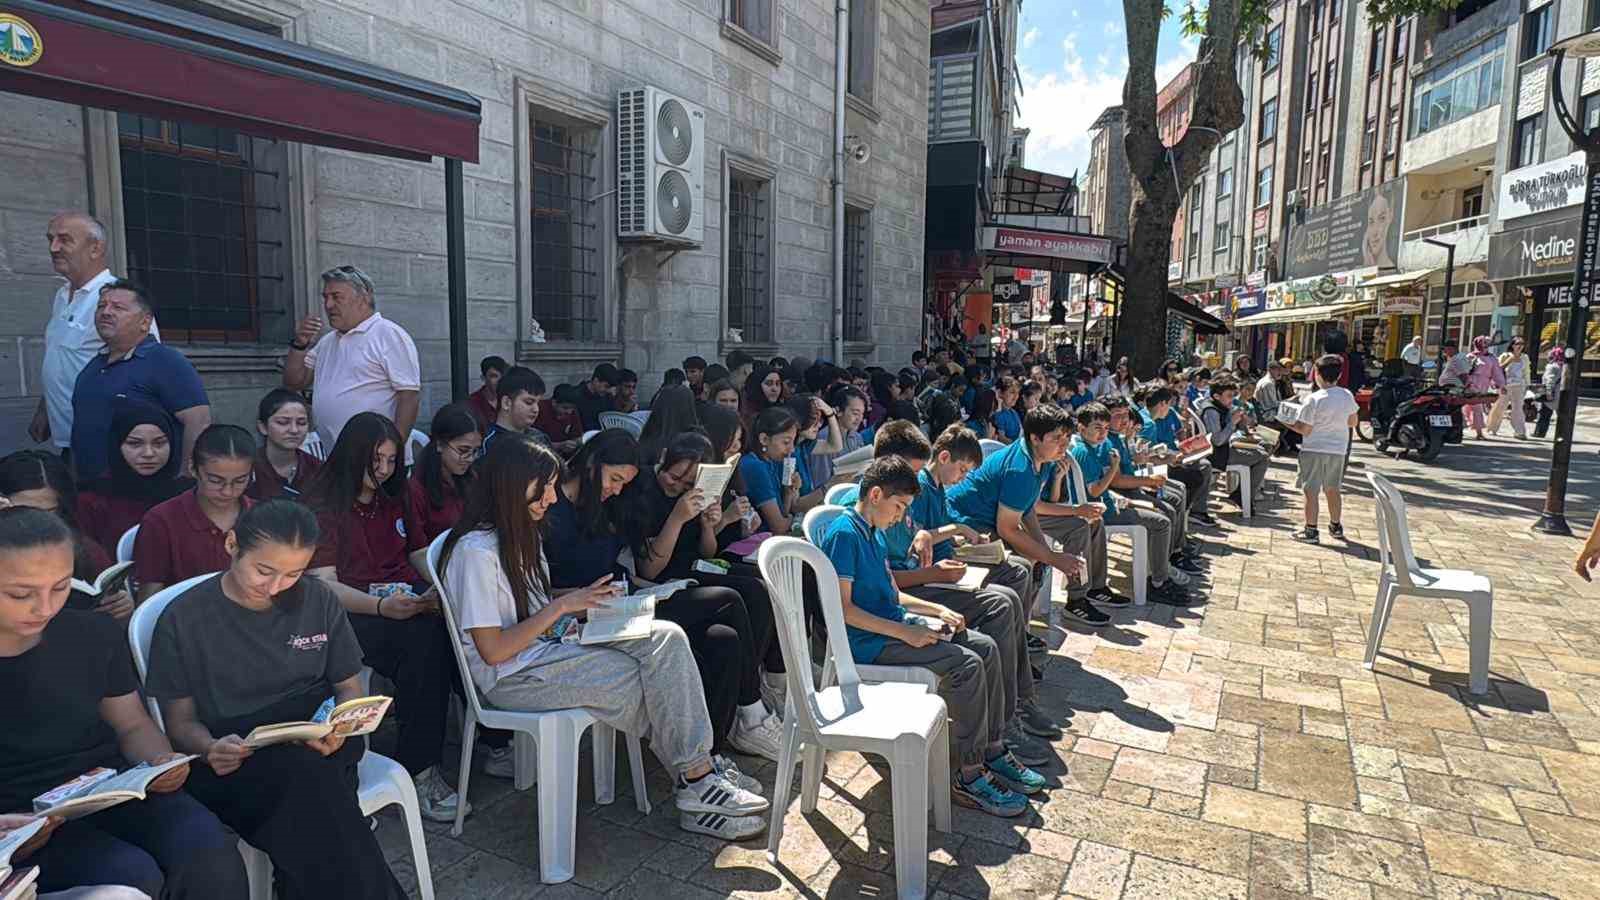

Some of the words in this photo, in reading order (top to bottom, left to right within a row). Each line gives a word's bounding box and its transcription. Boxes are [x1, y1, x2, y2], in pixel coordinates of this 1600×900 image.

[1539, 164, 1587, 190] TÜRKOĞLU
[999, 234, 1041, 247] yaman
[1044, 238, 1104, 254] ayakkabı
[1521, 235, 1575, 262] Medine
